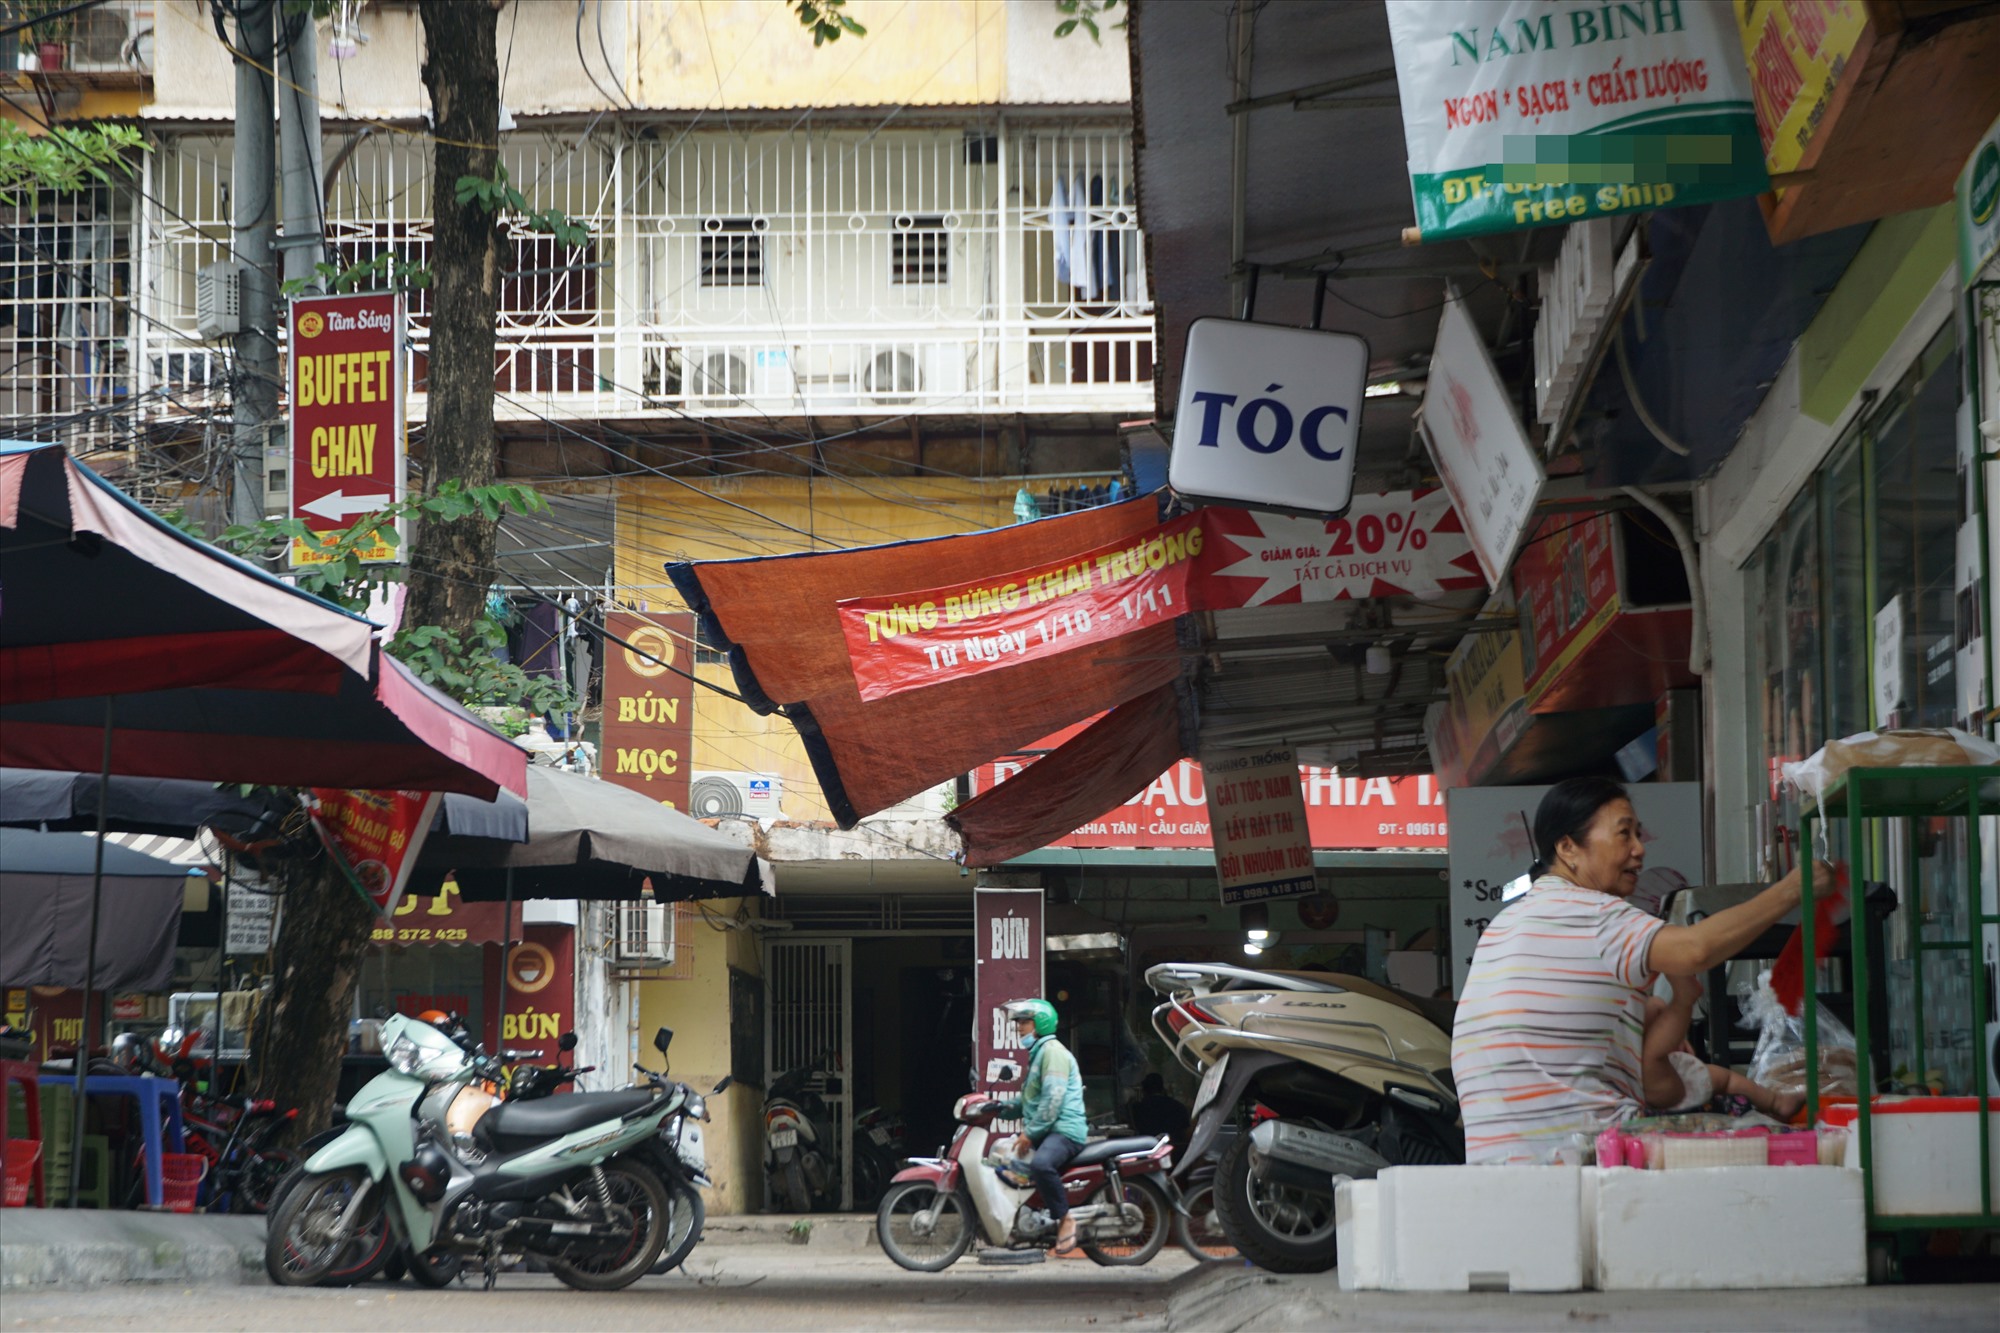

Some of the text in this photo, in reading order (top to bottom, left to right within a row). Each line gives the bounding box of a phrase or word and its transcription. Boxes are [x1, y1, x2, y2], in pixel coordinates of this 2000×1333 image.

[1449, 14, 1557, 66] NAM
[1443, 89, 1499, 130] NGON
[1517, 79, 1570, 125] SẠCH
[1587, 55, 1638, 107] CHẤT
[1640, 58, 1709, 103] LƯỢNG
[1513, 194, 1588, 225] Free
[1596, 182, 1675, 212] Ship
[327, 308, 391, 333] Tâm Sáng
[298, 350, 391, 407] BUFFET
[1191, 383, 1350, 462] TÓC
[311, 423, 377, 479] CHAY
[1295, 544, 1320, 559] GIÁ:
[1325, 510, 1427, 557] 20%
[945, 582, 1021, 624] BỪNG
[1027, 560, 1091, 606] KHAI
[1096, 526, 1204, 584] TRƯƠNG
[1293, 559, 1413, 581] TẤT CẢ DỊCH VỤ
[924, 643, 958, 671] Từ
[962, 629, 1028, 663] Ngày
[1034, 608, 1092, 645] 1/10
[1118, 583, 1173, 621] 1/11
[618, 690, 680, 724] BÚN
[616, 748, 678, 781] MỌC
[1205, 749, 1292, 773] QUANG THỐNG
[1239, 776, 1263, 803] TÓC
[1264, 775, 1293, 799] NAM
[353, 815, 389, 841] NAM
[1111, 822, 1137, 835] TÂN
[1149, 818, 1176, 835] CẦU
[1226, 811, 1294, 841] LẤY RÁY TAI
[1407, 822, 1434, 836] 0961
[1221, 842, 1310, 882] GỘI NHUỘM TÓC
[1243, 886, 1269, 899] 0984
[398, 928, 432, 941] 372
[435, 928, 468, 941] 425
[991, 908, 1030, 959] BÚN
[1283, 1000, 1347, 1010] LEAD
[502, 1006, 561, 1040] BÚN
